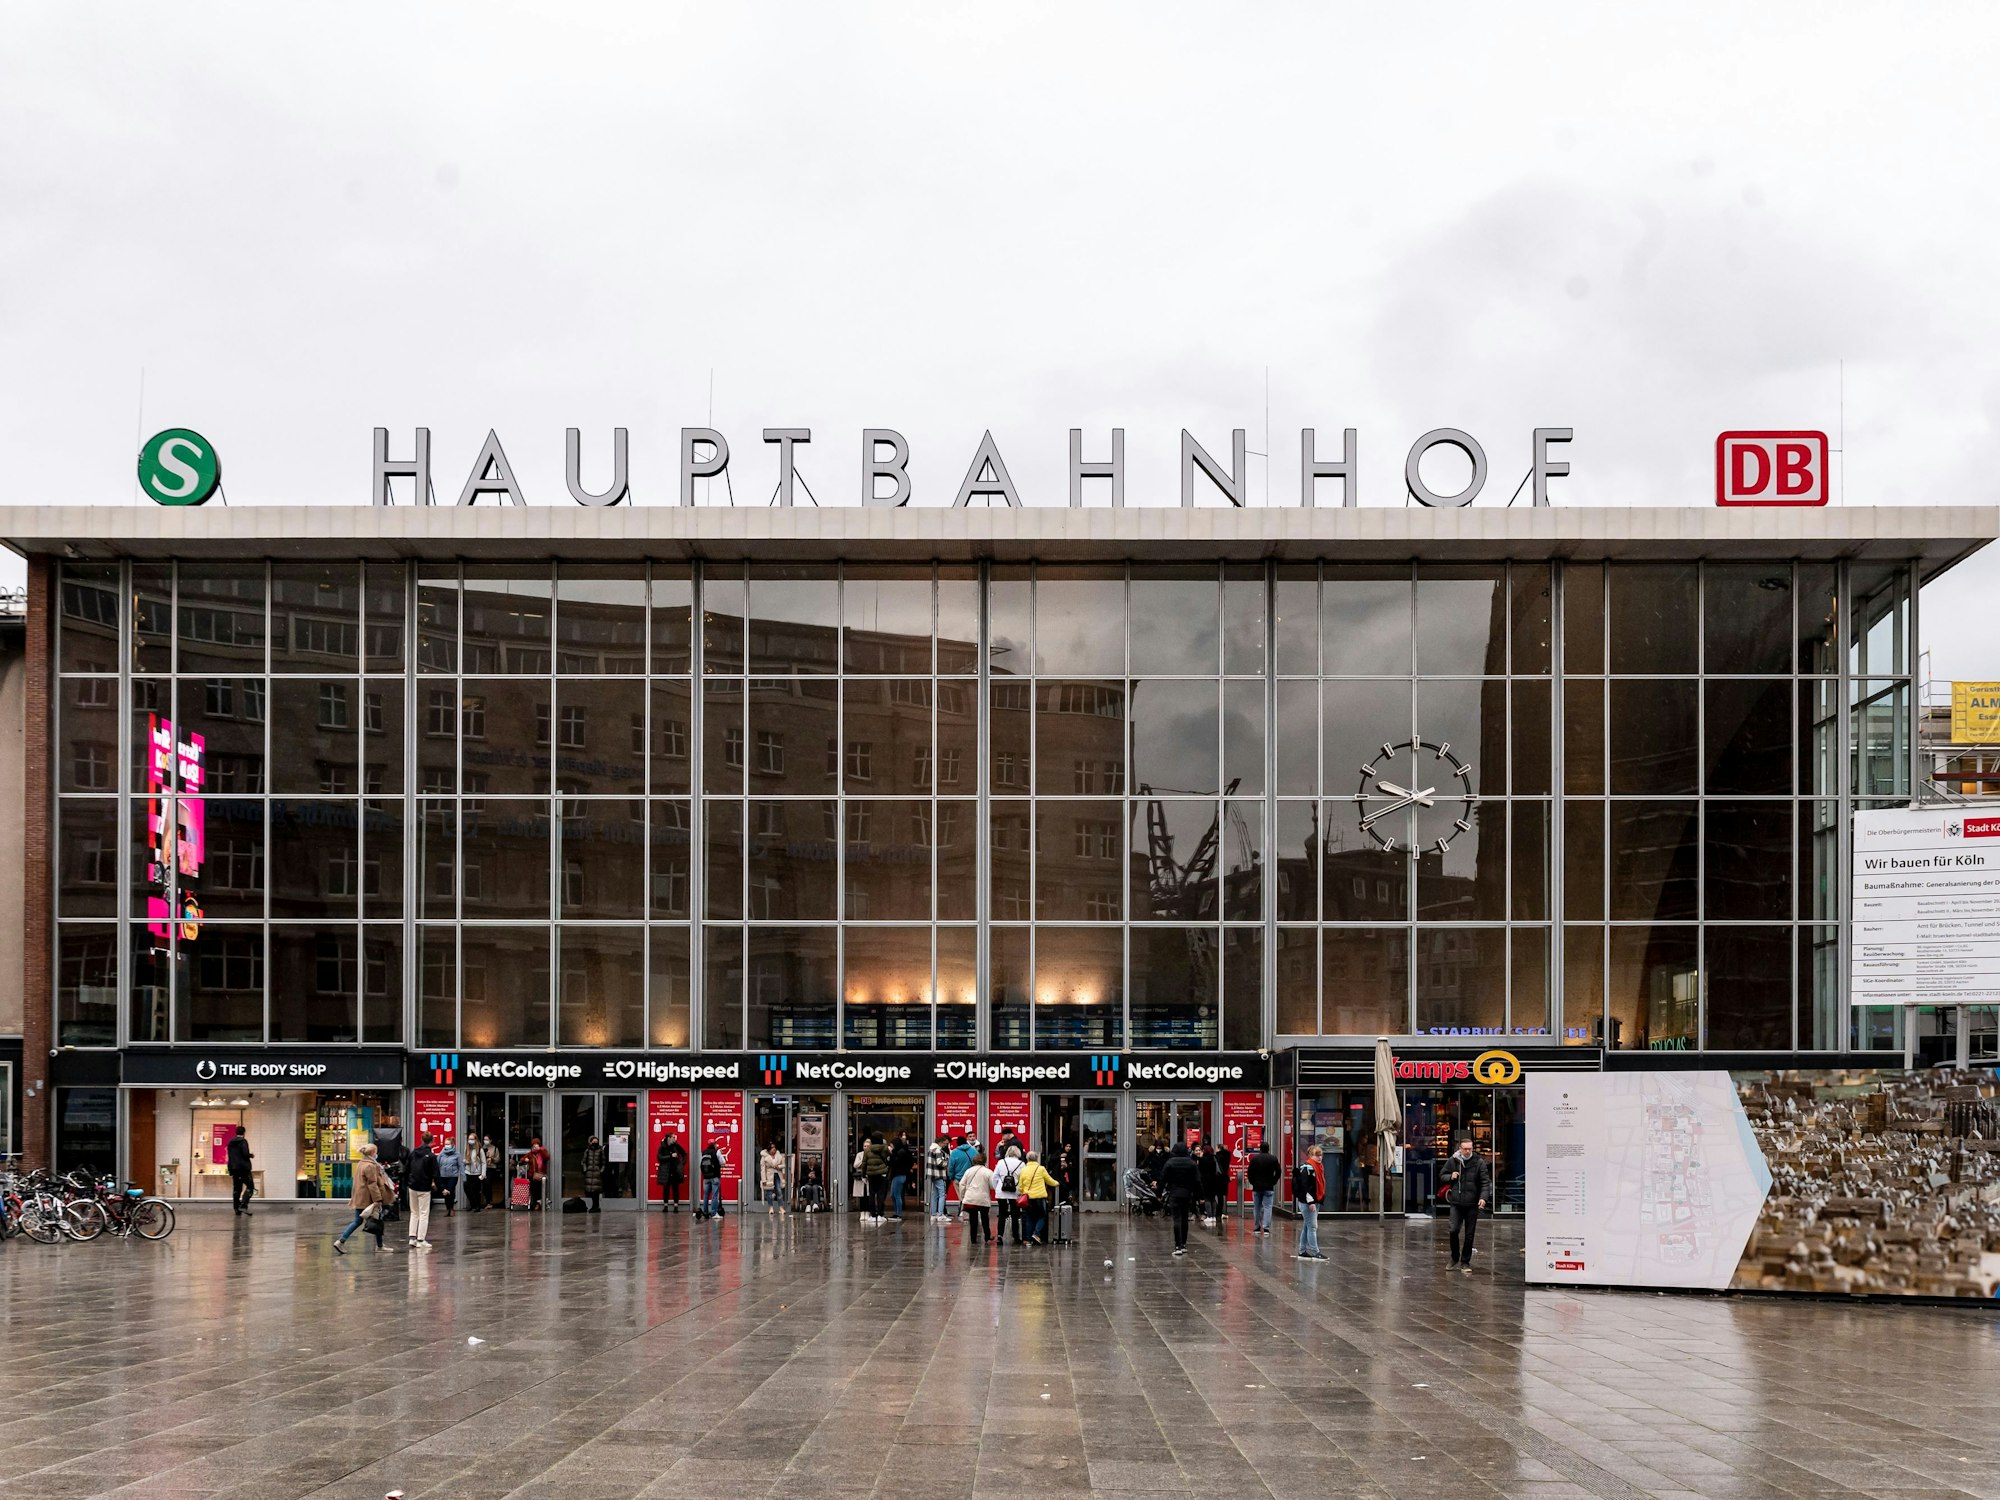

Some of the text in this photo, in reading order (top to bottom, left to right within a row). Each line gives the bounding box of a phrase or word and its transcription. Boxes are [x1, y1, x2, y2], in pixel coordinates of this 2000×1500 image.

[150, 437, 203, 498] S
[373, 428, 1573, 507] HAUPTBAHNHOF
[1731, 443, 1814, 496] DB
[1879, 827, 1942, 836] Oberbürgermeisterin
[1967, 823, 1989, 832] Stadt
[1865, 854, 1984, 869] Wir bauen für Köln
[1864, 882, 1924, 890] Baumaßnahme:
[1926, 880, 1981, 888] Generalsanierung
[220, 1064, 327, 1076] THE BODY SHOP
[466, 1061, 582, 1081] NetCologne
[637, 1061, 739, 1082] Highspeed
[796, 1062, 911, 1082] NetCologne
[968, 1062, 1070, 1082] Highspeed
[1127, 1062, 1243, 1083] NetCologne
[876, 1096, 924, 1104] Information
[304, 1111, 316, 1139] REFILL
